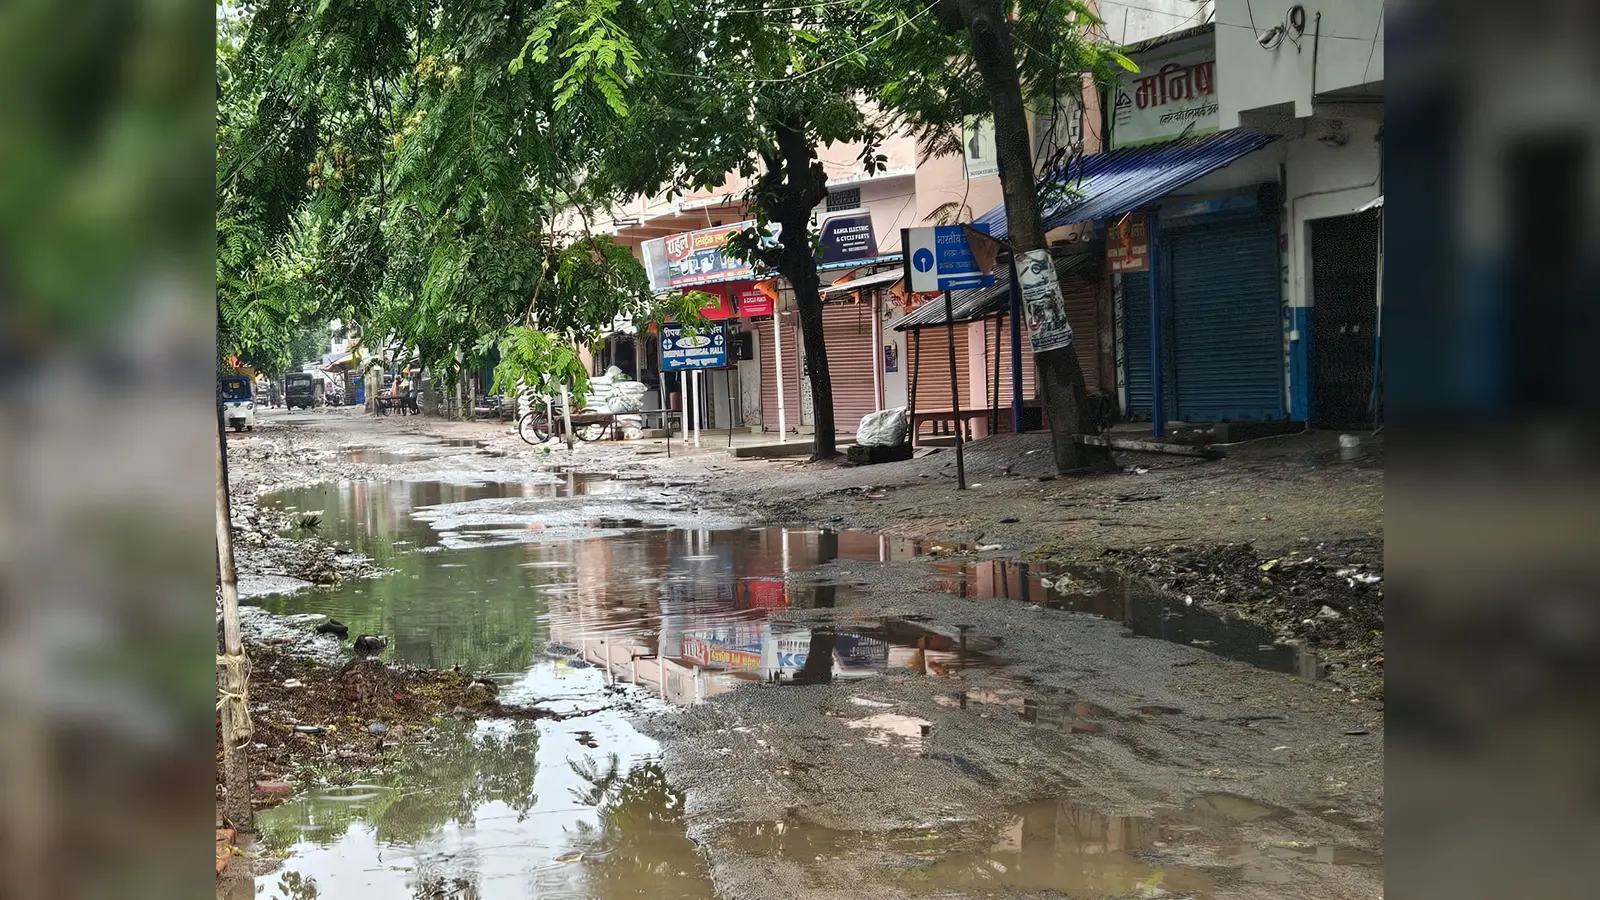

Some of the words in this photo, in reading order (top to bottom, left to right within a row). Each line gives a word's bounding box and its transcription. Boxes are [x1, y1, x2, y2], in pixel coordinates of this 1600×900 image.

[937, 231, 961, 245] भारतीय
[666, 234, 689, 257] राहुल
[710, 346, 724, 355] HALL
